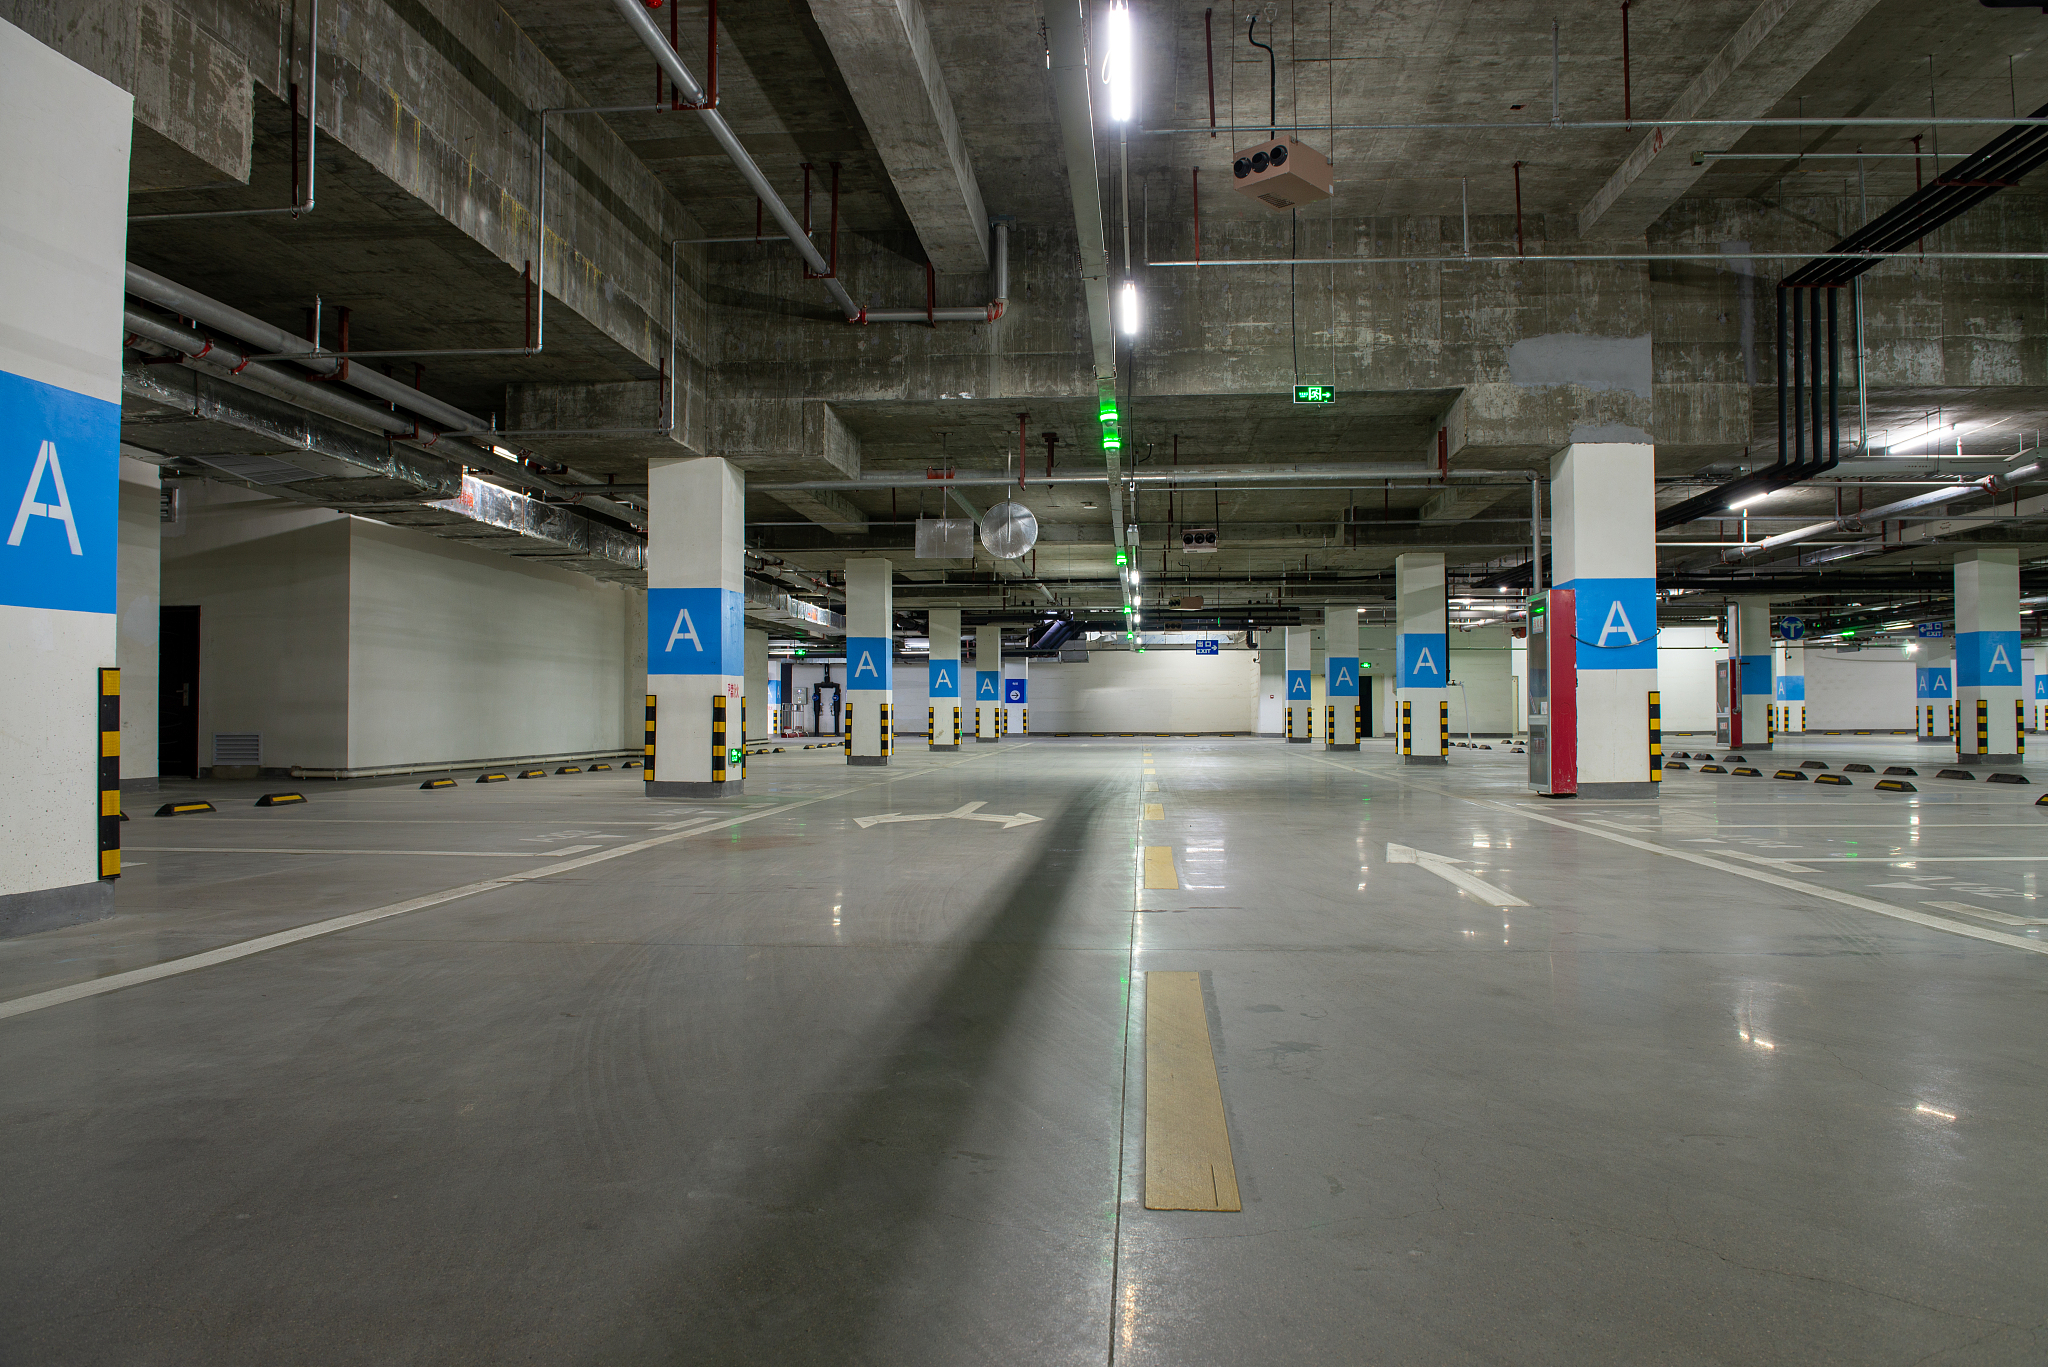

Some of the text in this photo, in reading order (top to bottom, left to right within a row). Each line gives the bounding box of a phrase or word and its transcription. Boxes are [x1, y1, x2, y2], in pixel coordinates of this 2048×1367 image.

[7, 439, 83, 556] A
[664, 608, 704, 652] A
[1597, 601, 1640, 647] A
[854, 650, 879, 678] A
[1412, 646, 1439, 675] A
[1988, 644, 2013, 673] A
[935, 669, 952, 688] A
[981, 678, 995, 694] A
[1292, 676, 1306, 693] A
[1335, 666, 1353, 687] A
[1919, 675, 1928, 692] A
[1933, 674, 1948, 691] A
[1779, 682, 1784, 695] A
[2037, 680, 2045, 695] A
[1886, 874, 2044, 898] A182
